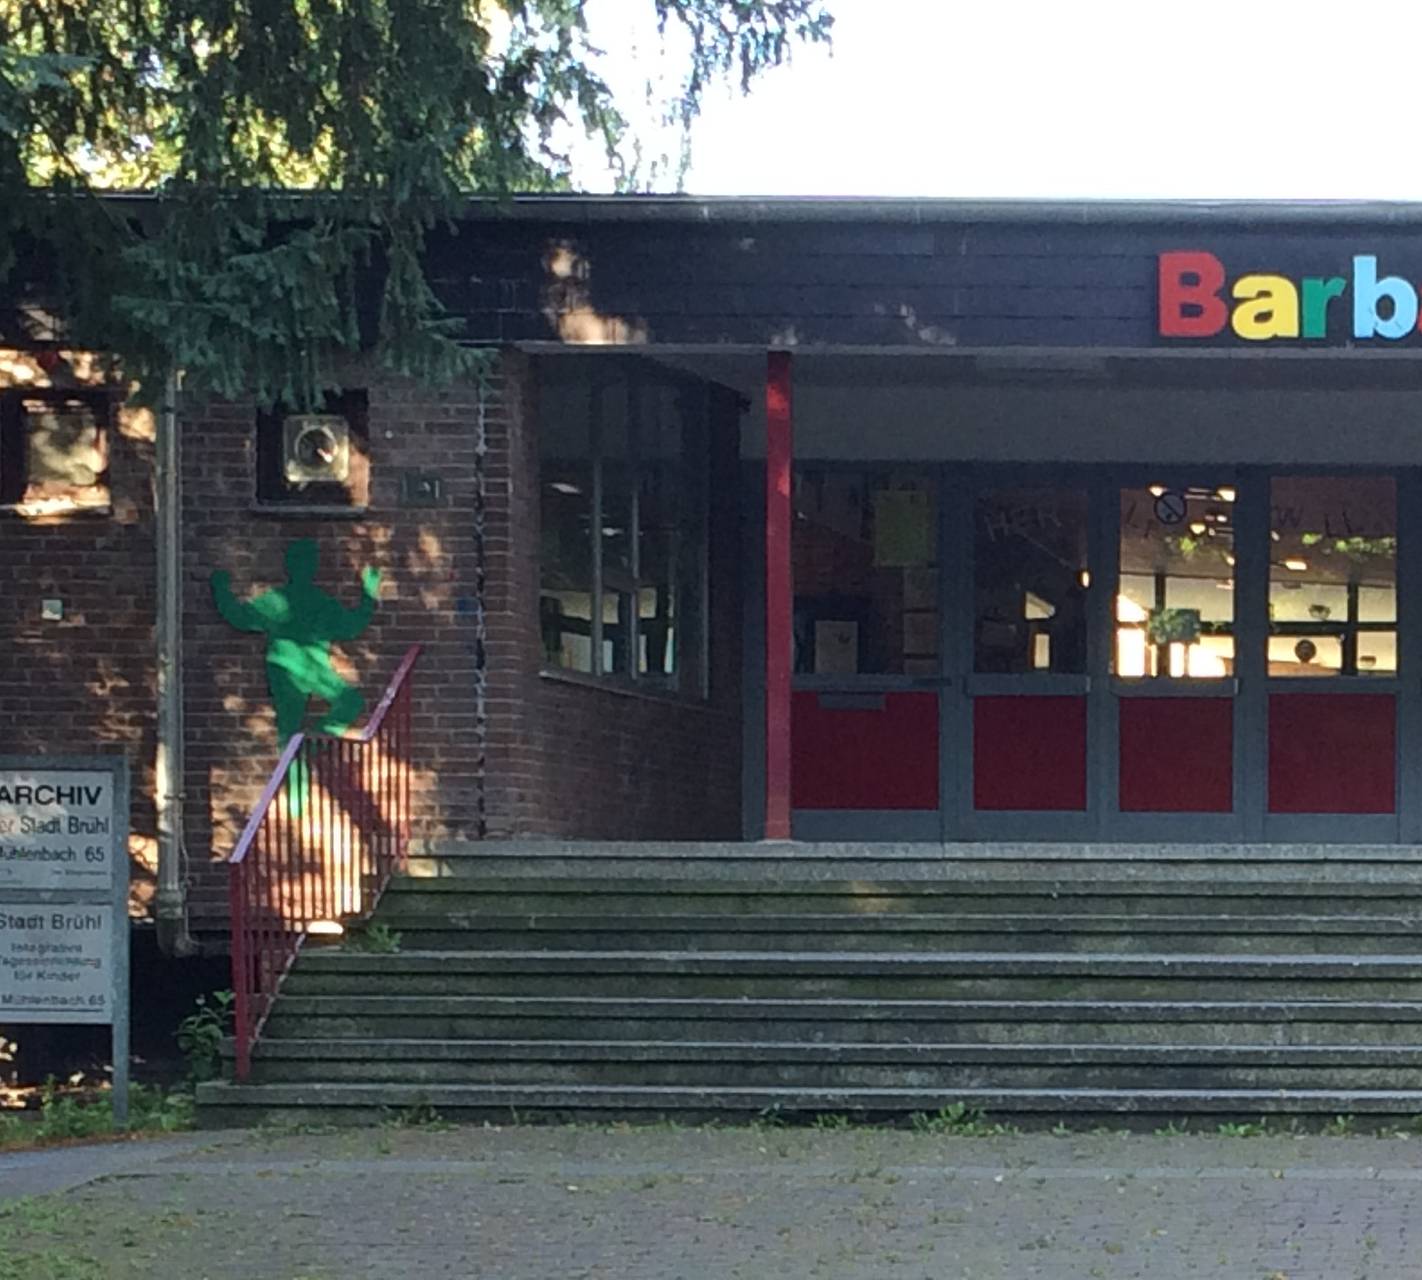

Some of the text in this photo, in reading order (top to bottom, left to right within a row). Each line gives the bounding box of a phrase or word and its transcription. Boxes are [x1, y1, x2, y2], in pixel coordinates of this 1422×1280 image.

[0, 784, 103, 806] ARCHIV
[20, 815, 62, 835] Stadt
[84, 845, 105, 862] 65
[0, 912, 103, 930] Stadt Brühl
[88, 994, 106, 1006] 65
